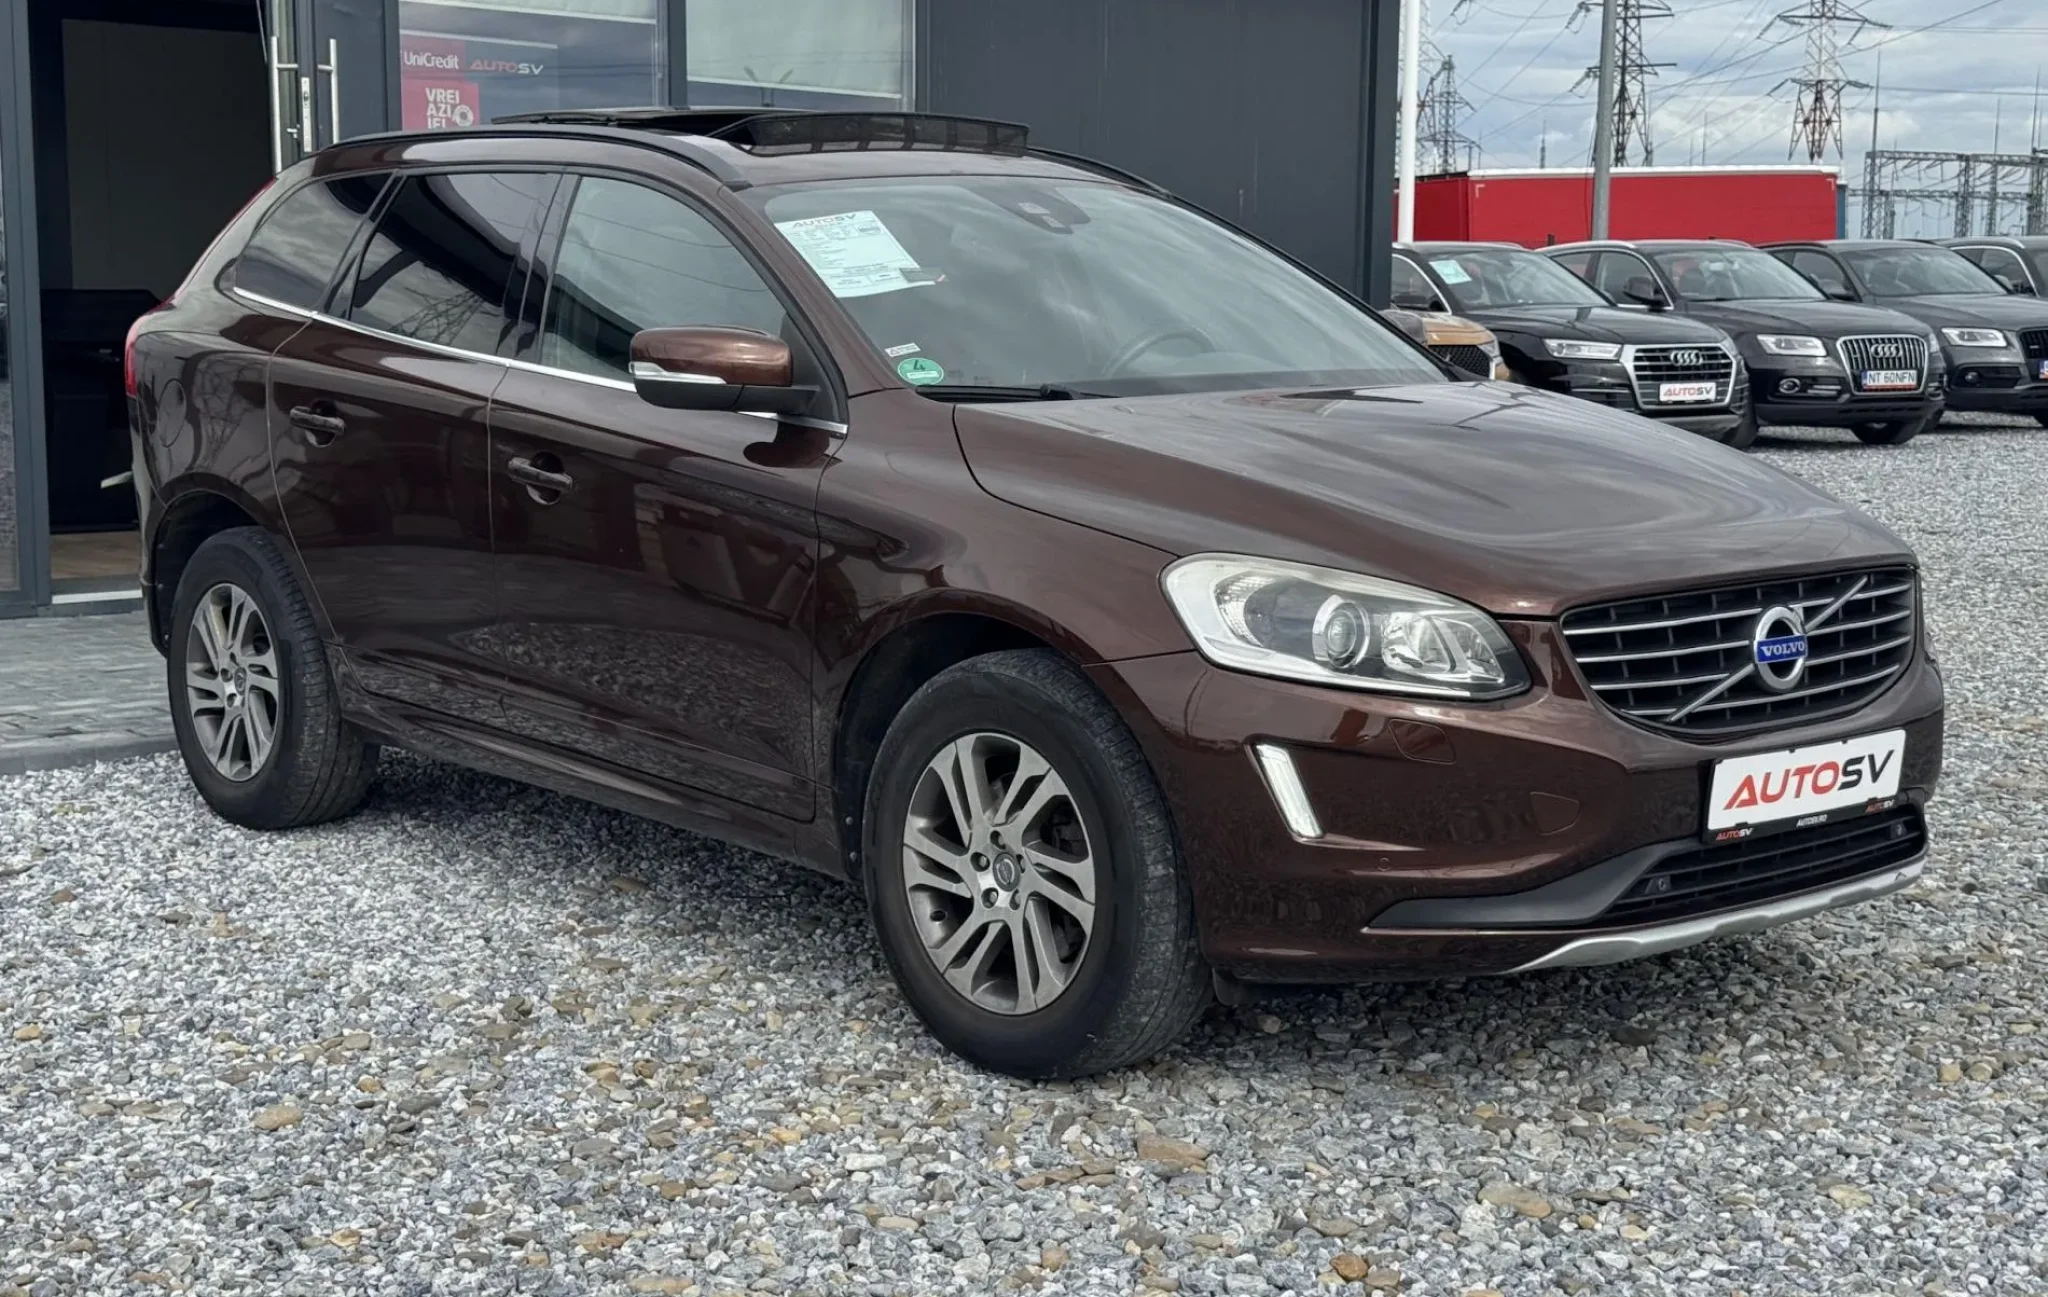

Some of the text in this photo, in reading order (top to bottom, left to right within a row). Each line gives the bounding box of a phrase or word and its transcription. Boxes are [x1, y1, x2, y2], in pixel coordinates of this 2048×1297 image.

[404, 51, 459, 70] UniCredit
[425, 87, 460, 104] VREI
[427, 103, 451, 118] AZI
[1869, 372, 1881, 384] NT
[1663, 386, 1713, 397] AUTOSV
[1760, 641, 1805, 657] VOLVO
[1723, 750, 1895, 810] AUTOSV
[1715, 827, 1753, 841] AUTOSV
